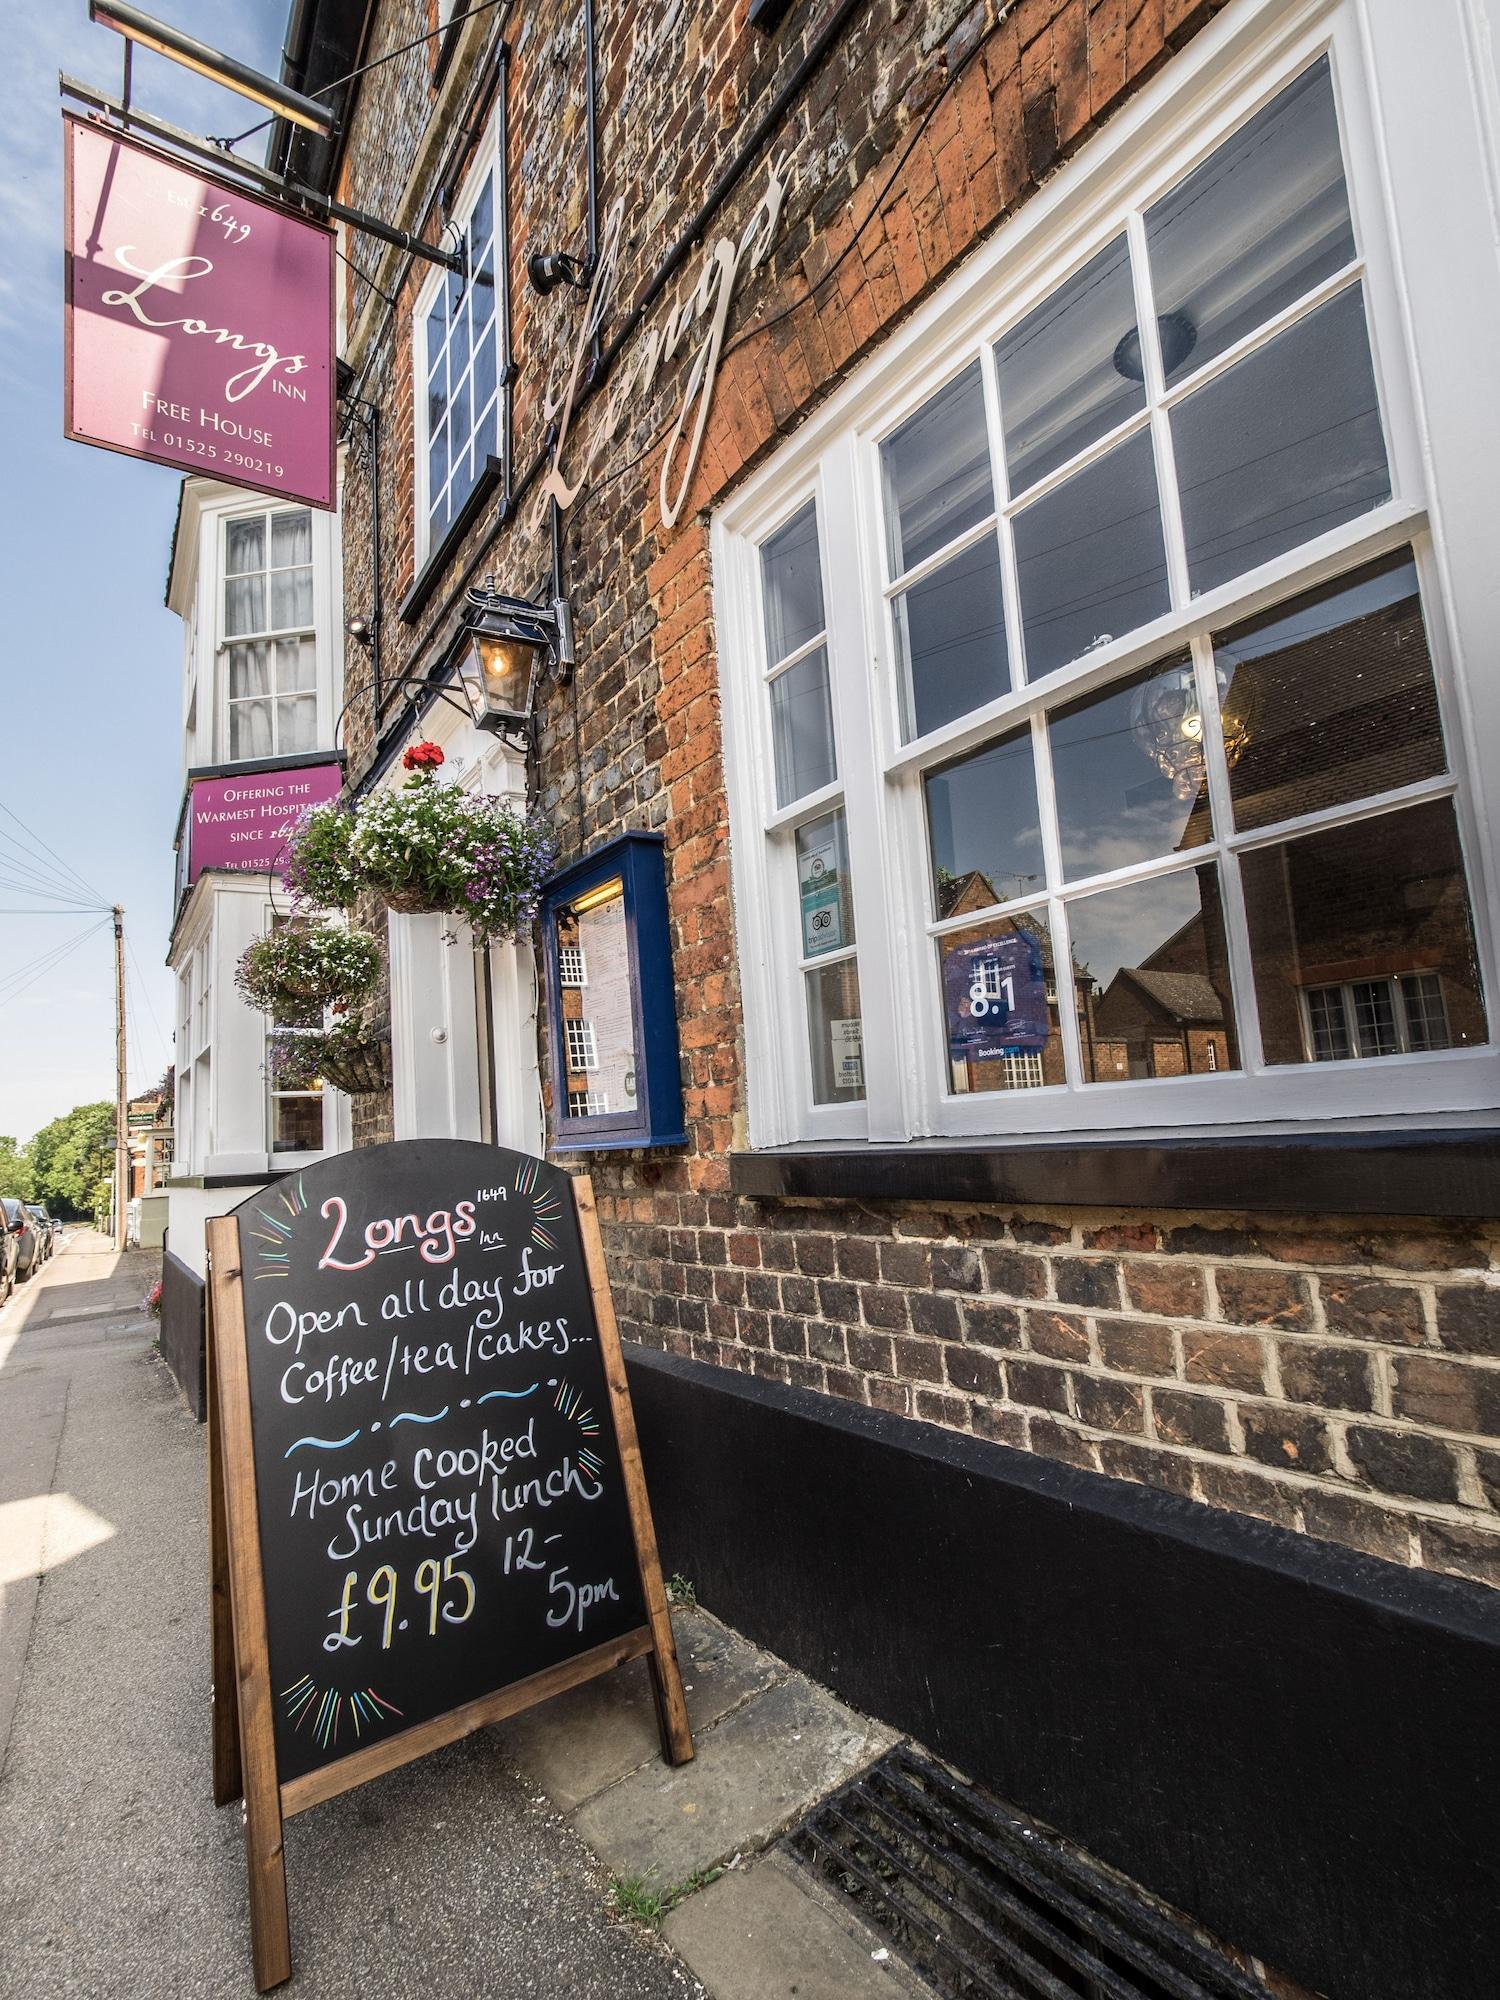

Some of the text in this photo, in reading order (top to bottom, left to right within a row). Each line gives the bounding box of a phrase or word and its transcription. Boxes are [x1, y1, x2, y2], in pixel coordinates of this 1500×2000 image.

[194, 203, 251, 245] 1649
[101, 245, 309, 402] Longs
[530, 149, 796, 530] Longs
[142, 390, 274, 448] FREE HOUSE
[272, 379, 307, 402] INN
[130, 422, 285, 478] TEL 01525 290219
[197, 808, 256, 825] WARMEST
[223, 783, 311, 802] OFFERING THE
[230, 819, 296, 843] SINCE 164
[241, 857, 270, 869] 01525
[969, 976, 1016, 1018] 8.1
[317, 1186, 508, 1271] Longs 1649
[265, 1246, 565, 1355] Open all day for
[289, 1417, 538, 1520] Home Cooked
[326, 1456, 604, 1561] Sunday lunch
[322, 1548, 477, 1653] £9.95
[545, 1565, 621, 1632] 5pm
